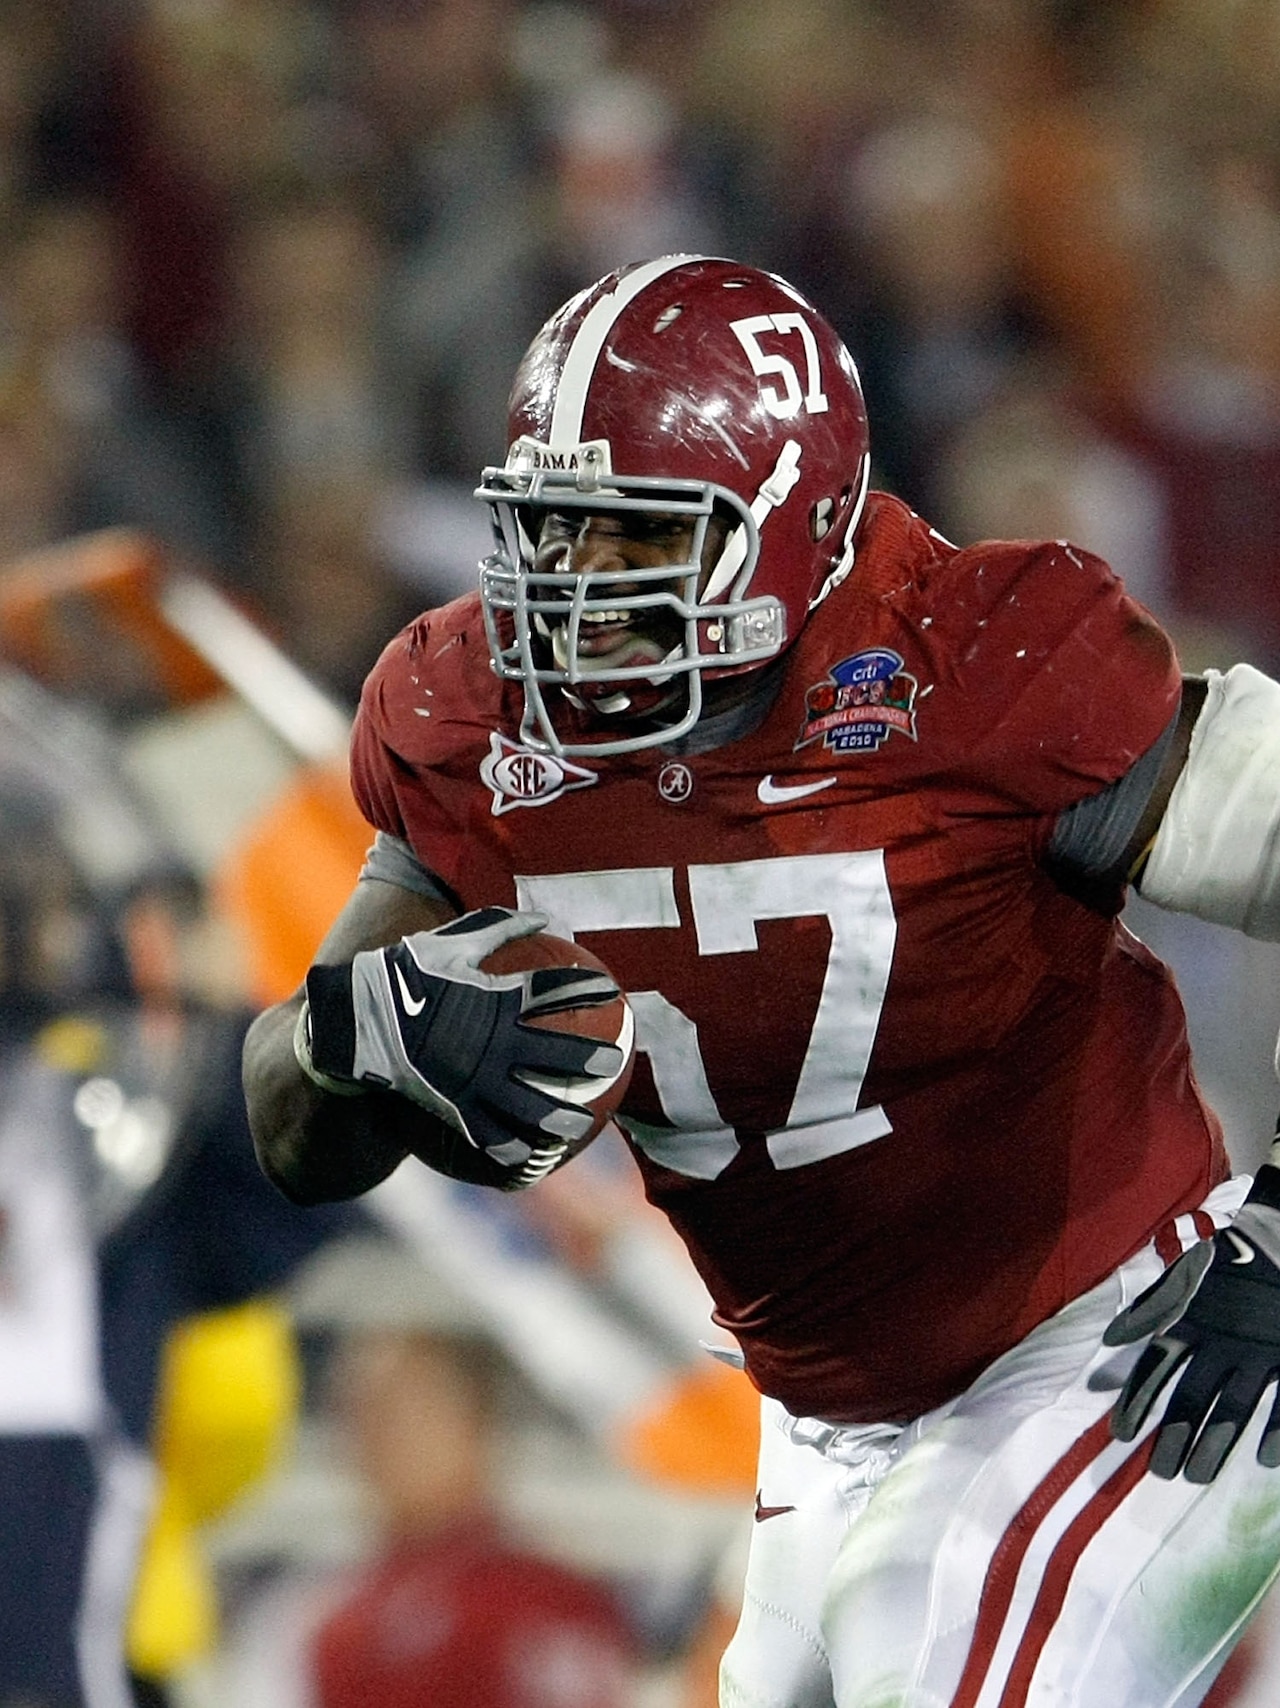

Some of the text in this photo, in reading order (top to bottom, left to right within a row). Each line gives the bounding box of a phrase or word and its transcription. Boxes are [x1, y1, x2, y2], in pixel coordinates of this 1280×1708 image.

[728, 312, 829, 421] 57
[533, 452, 578, 470] BAMA
[852, 664, 878, 682] citi
[839, 735, 872, 748] 2010
[508, 756, 546, 796] SEC
[514, 849, 897, 1180] 57
